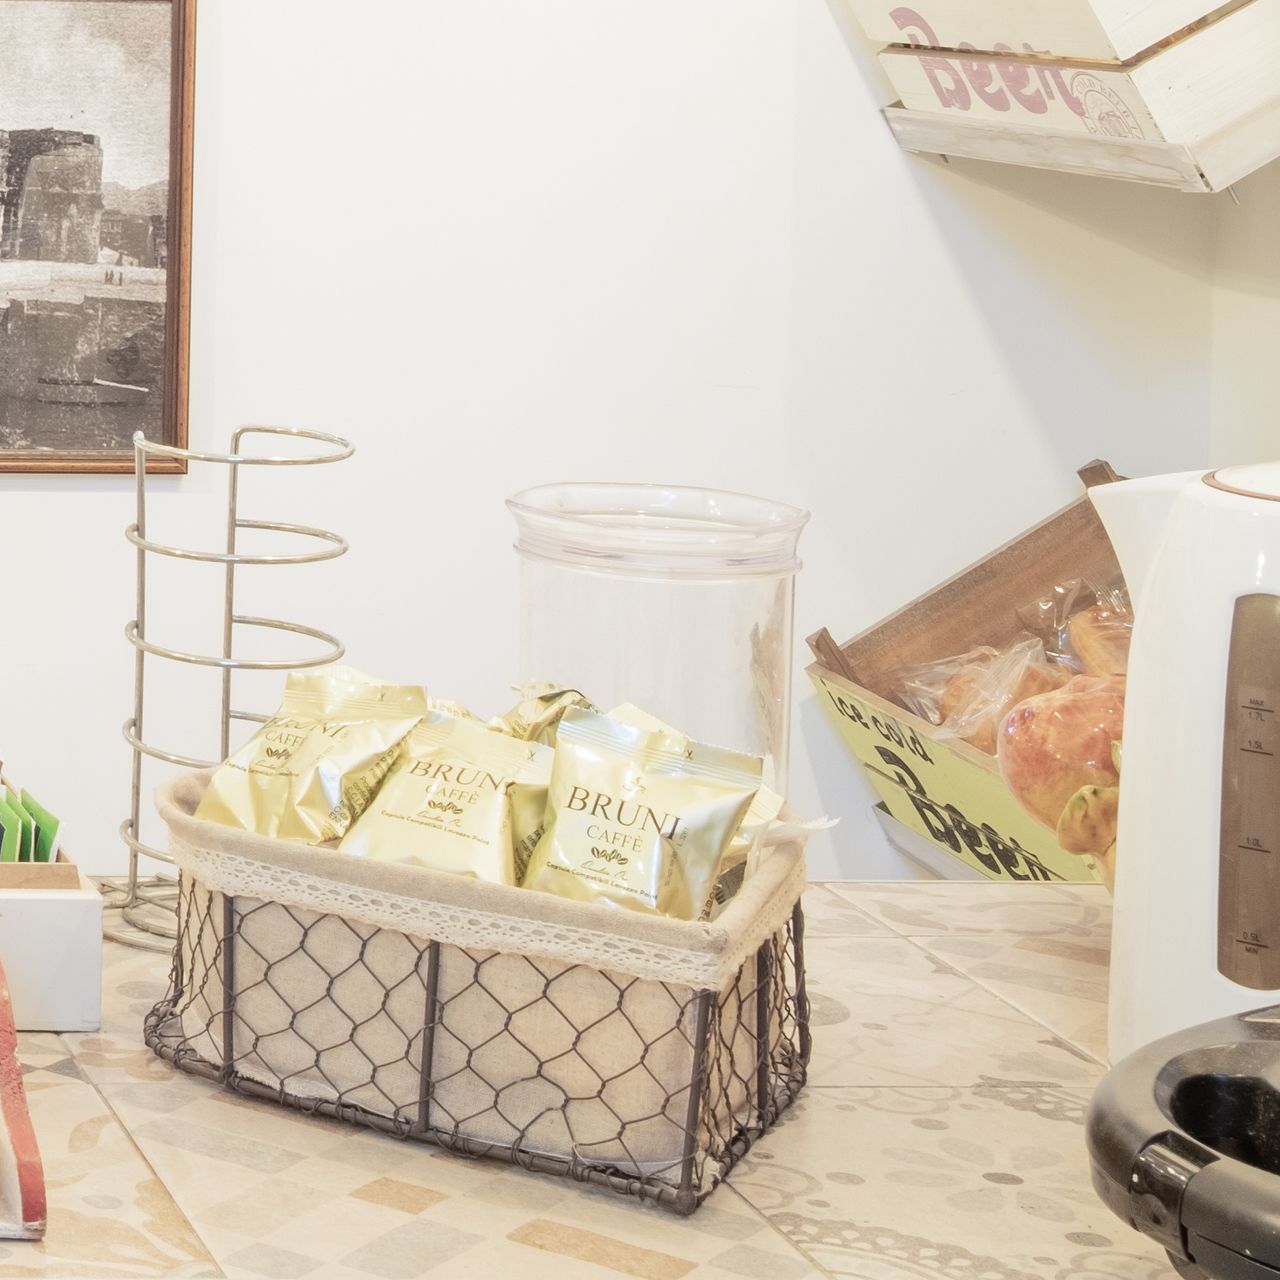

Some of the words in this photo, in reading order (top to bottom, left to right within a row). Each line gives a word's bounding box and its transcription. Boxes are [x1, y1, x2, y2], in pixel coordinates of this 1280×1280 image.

[888, 6, 1086, 117] Beer
[820, 678, 871, 730] ice
[871, 715, 934, 765] cold
[1249, 697, 1265, 707] MAX
[565, 785, 680, 841] BRUNI
